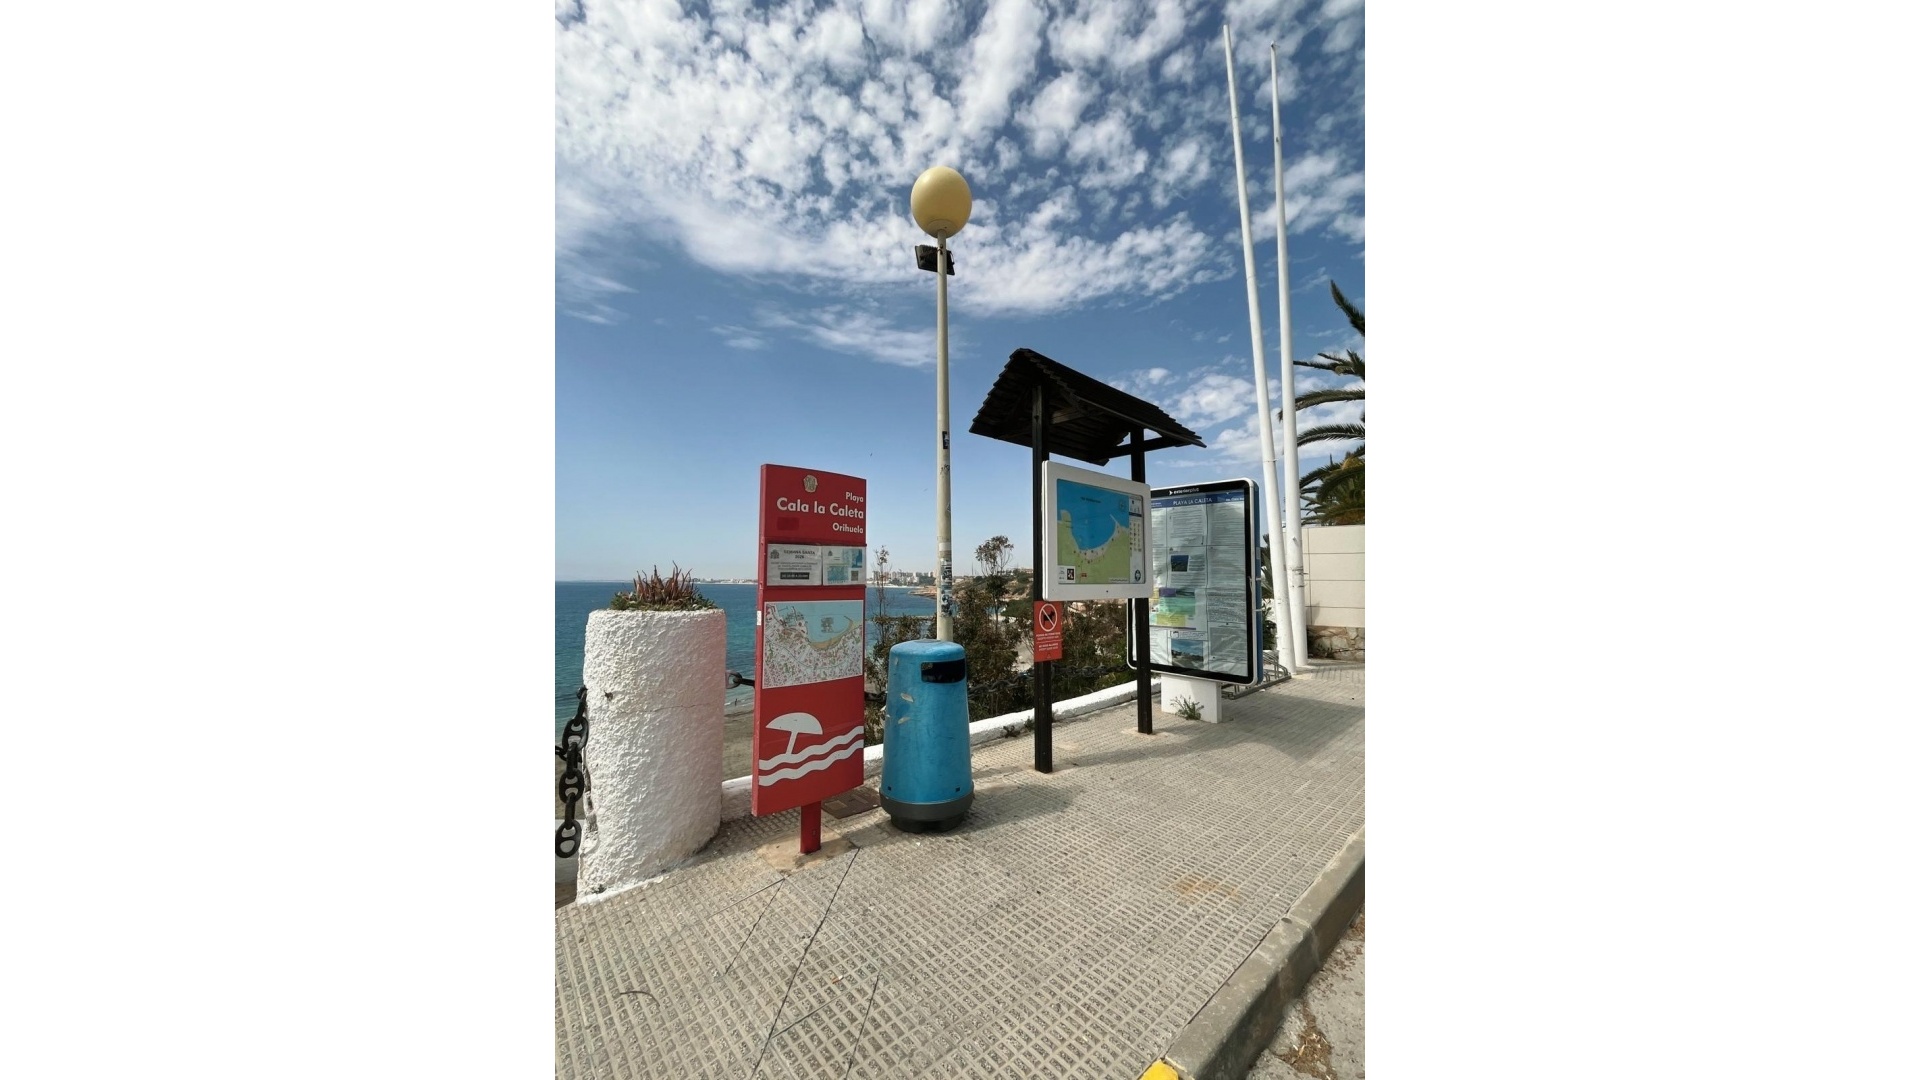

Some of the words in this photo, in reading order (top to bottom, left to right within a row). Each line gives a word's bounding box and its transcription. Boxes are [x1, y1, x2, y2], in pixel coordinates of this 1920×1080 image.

[846, 492, 864, 503] Playa
[777, 497, 809, 513] Cala
[814, 501, 826, 514] la
[830, 503, 864, 519] Caleta
[832, 523, 864, 534] Orihuela
